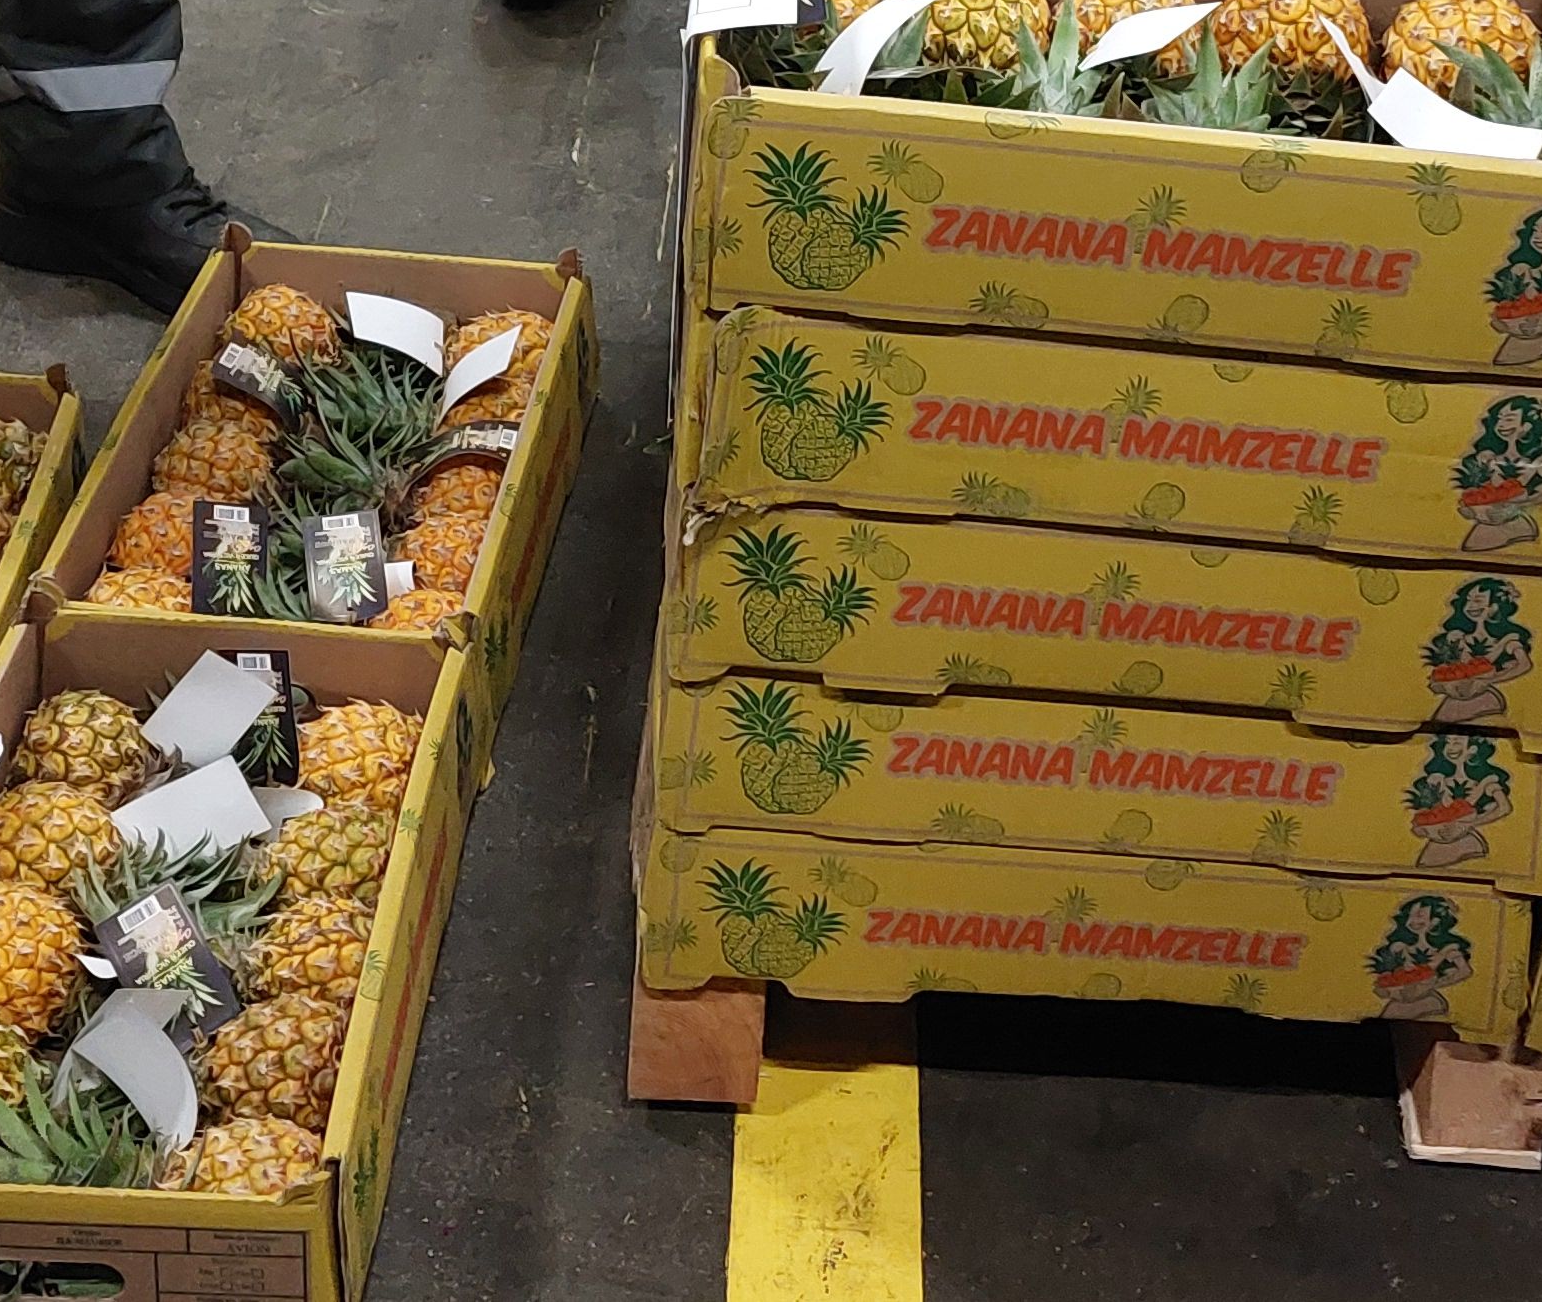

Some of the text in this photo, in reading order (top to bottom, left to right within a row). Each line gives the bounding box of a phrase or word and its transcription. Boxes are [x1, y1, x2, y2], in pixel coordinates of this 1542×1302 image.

[926, 207, 1413, 292] ZANANA MAMZELLE
[906, 400, 1381, 480] ZANANA MAMZELLE
[893, 584, 1354, 658] ZANANA MAMZELLE
[888, 735, 1335, 804] ZANANA MAMZELLE
[154, 955, 194, 990] ANANAS
[863, 910, 1301, 968] ZANANA MAMZELLE
